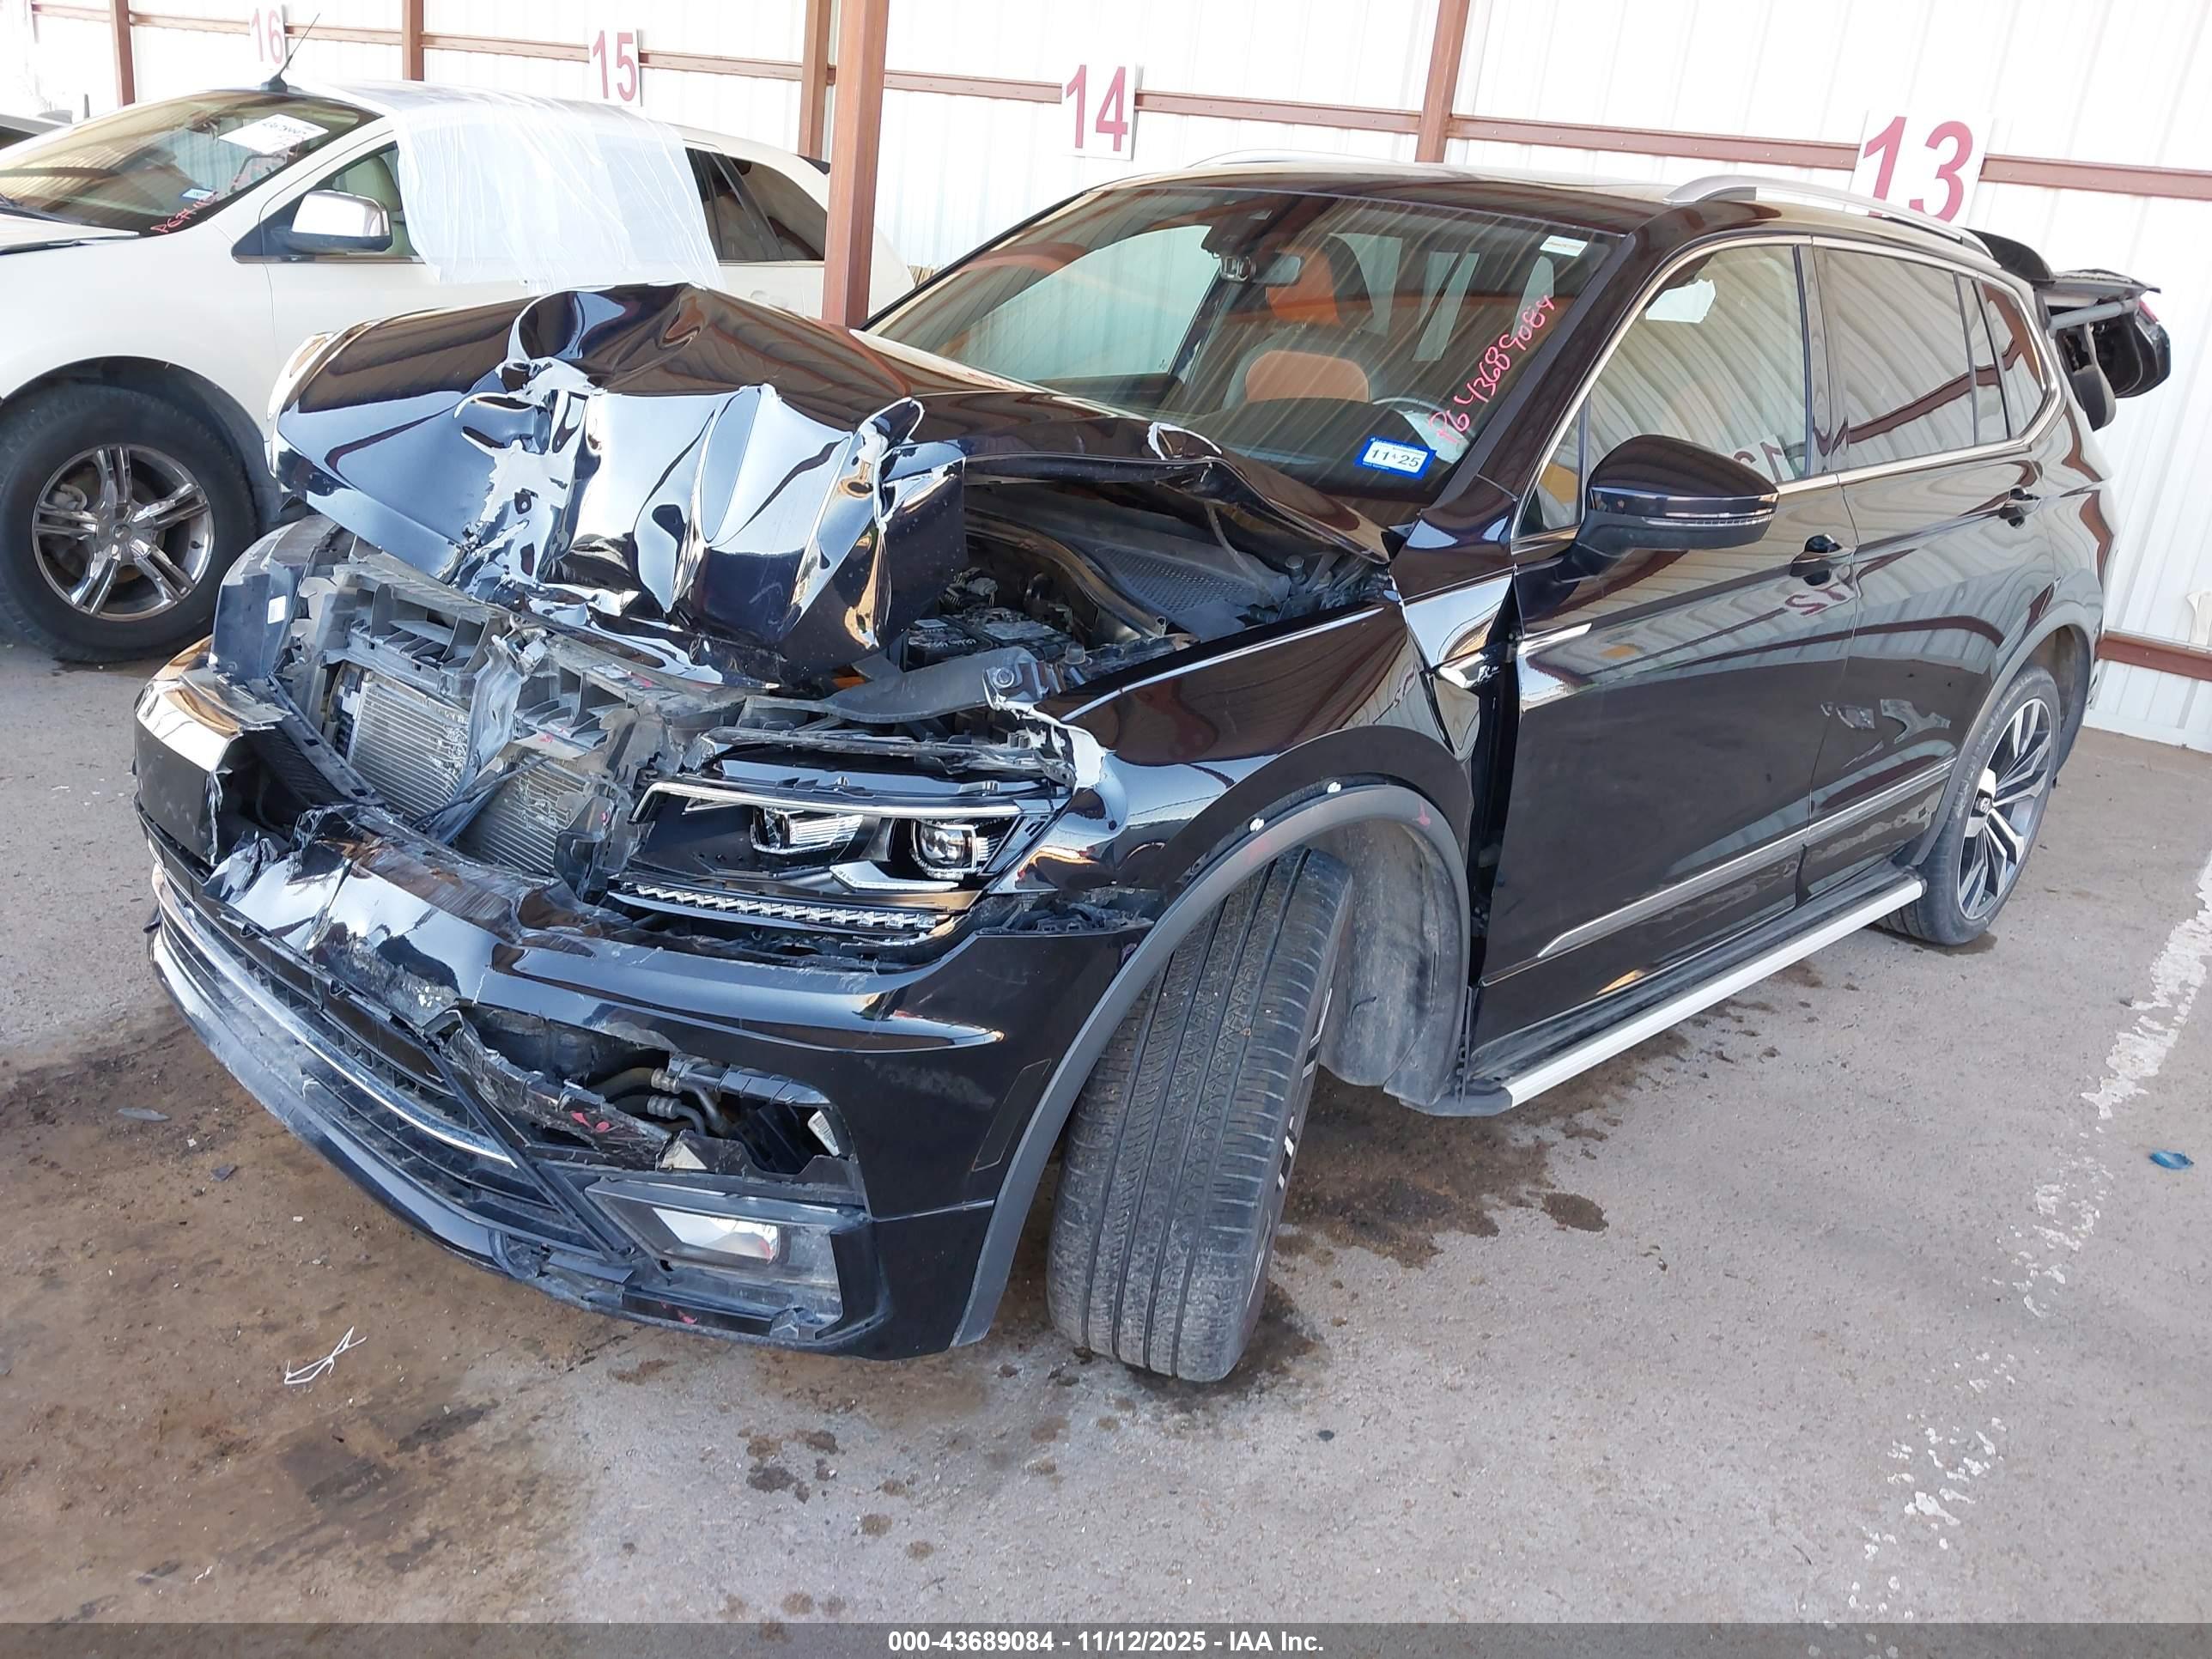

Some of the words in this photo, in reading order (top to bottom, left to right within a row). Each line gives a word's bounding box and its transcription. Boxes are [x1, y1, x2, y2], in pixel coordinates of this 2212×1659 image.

[251, 9, 283, 64] 16
[593, 31, 636, 101] 15
[1066, 64, 1128, 152] 14
[1863, 115, 1973, 223] 13
[1453, 295, 1556, 404] 43689084
[1371, 449, 1390, 462] 11
[1397, 454, 1422, 468] 25
